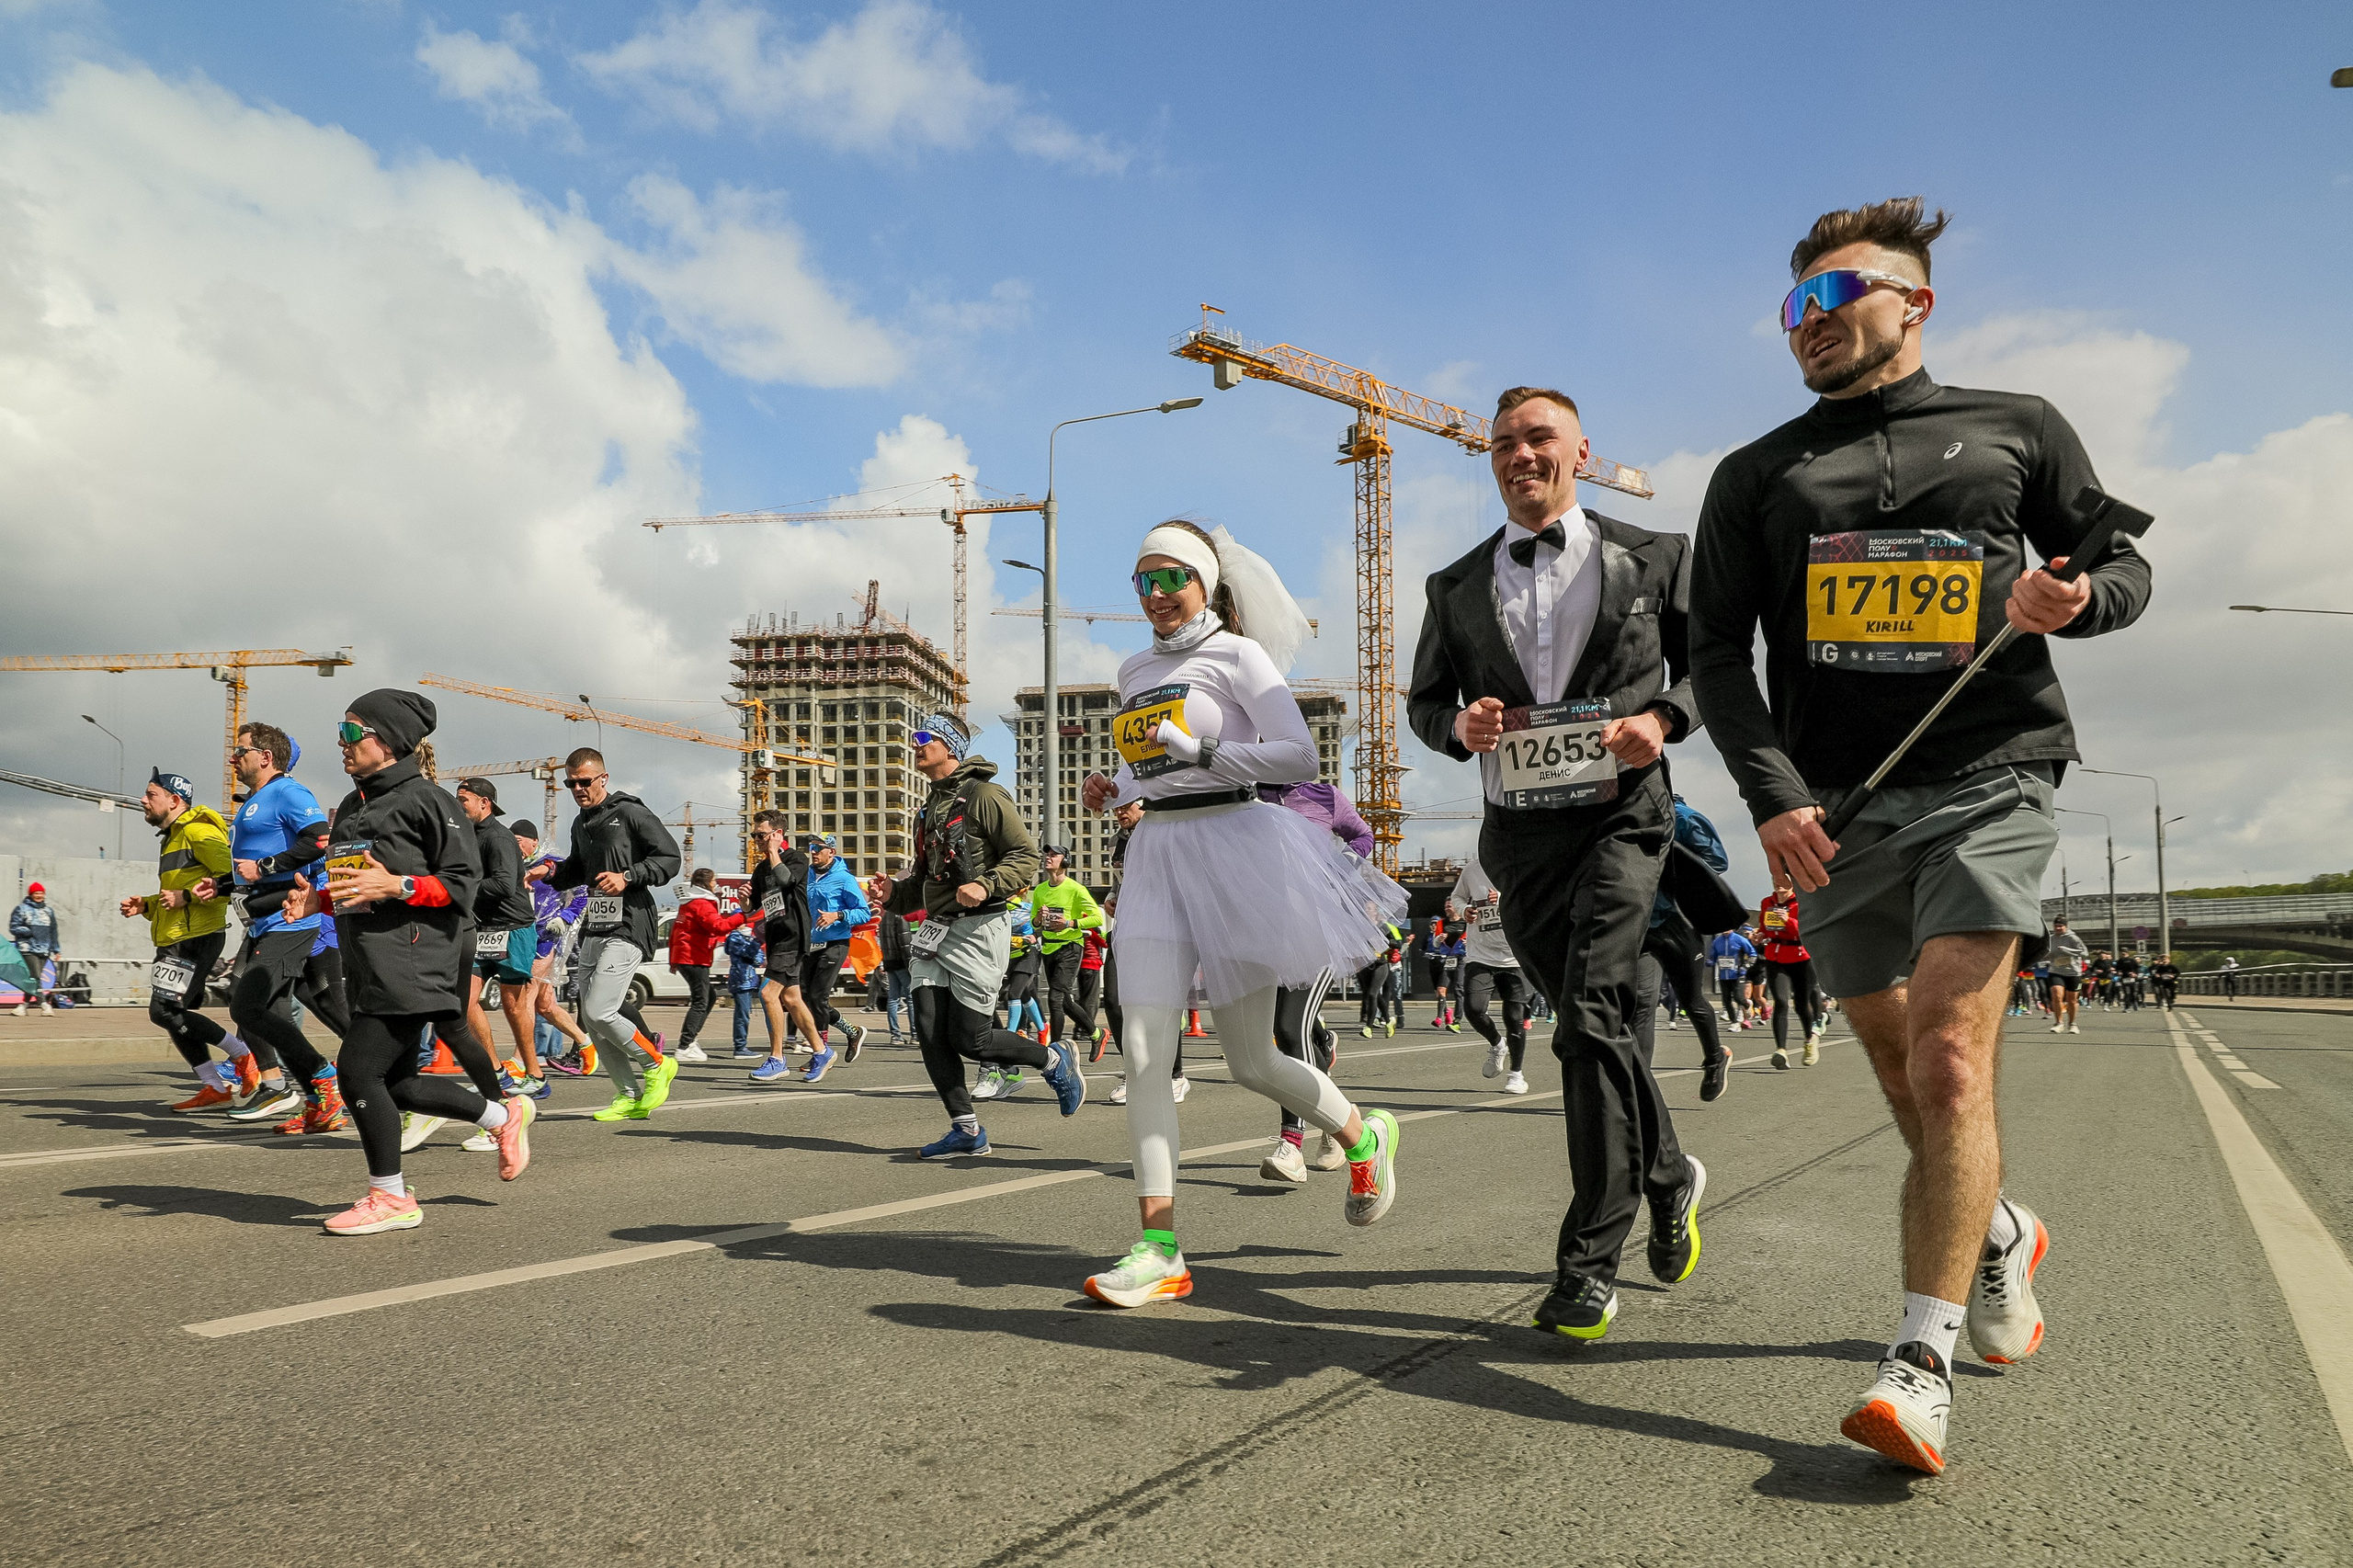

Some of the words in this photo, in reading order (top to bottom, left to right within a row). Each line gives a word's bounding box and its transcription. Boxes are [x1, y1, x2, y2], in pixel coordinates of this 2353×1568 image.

[1869, 537, 1925, 546] МОСКОВСКИЙ
[1868, 551, 1908, 559] МАРАФОН
[1819, 574, 1970, 616] 17198
[1865, 619, 1915, 633] KIRILL
[1822, 642, 1839, 664] G
[1505, 730, 1607, 770] 12653
[1539, 767, 1571, 781] ДЕНИС
[1515, 790, 1528, 807] E
[589, 901, 617, 914] 4056
[478, 934, 504, 945] 9669
[919, 924, 942, 942] 2797
[153, 965, 185, 983] 2701
